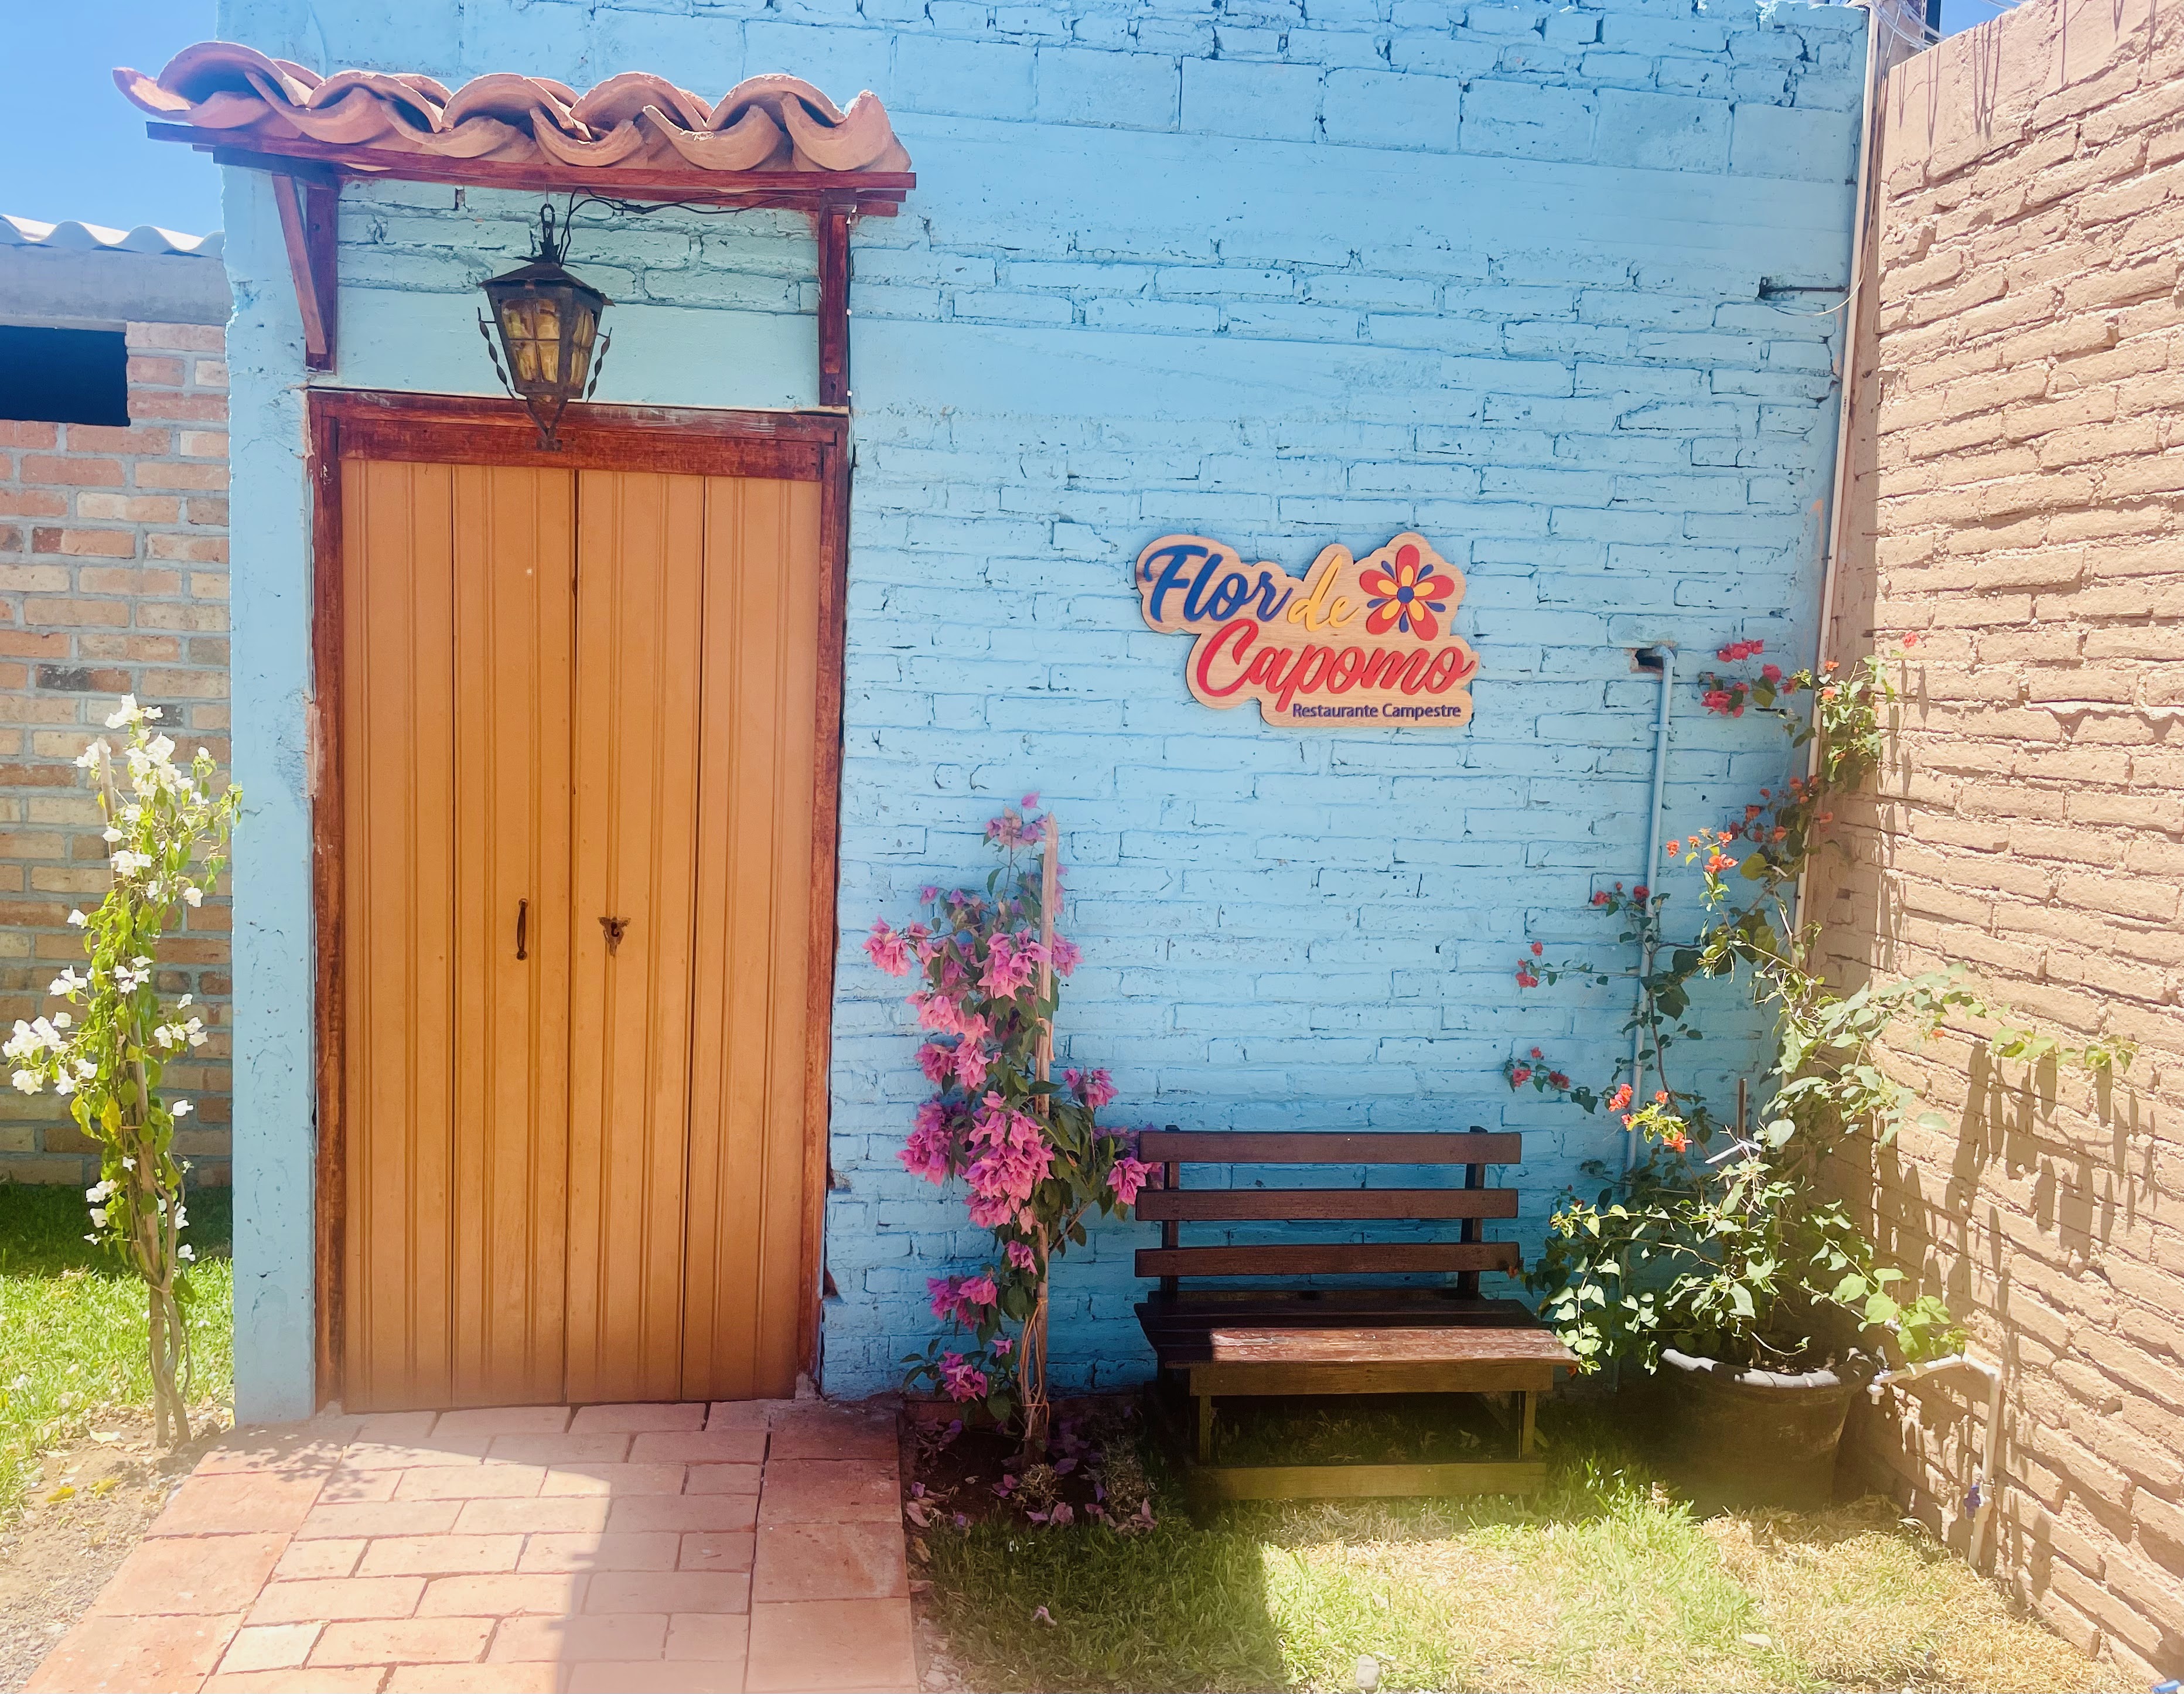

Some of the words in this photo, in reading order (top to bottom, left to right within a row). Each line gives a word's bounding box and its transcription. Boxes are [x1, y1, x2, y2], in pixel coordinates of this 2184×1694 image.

[1144, 544, 1294, 623] Flor
[1288, 554, 1360, 632] de
[1197, 619, 1476, 713] Capomo
[1292, 703, 1378, 718] Restaurante
[1383, 703, 1462, 721] Campestre
